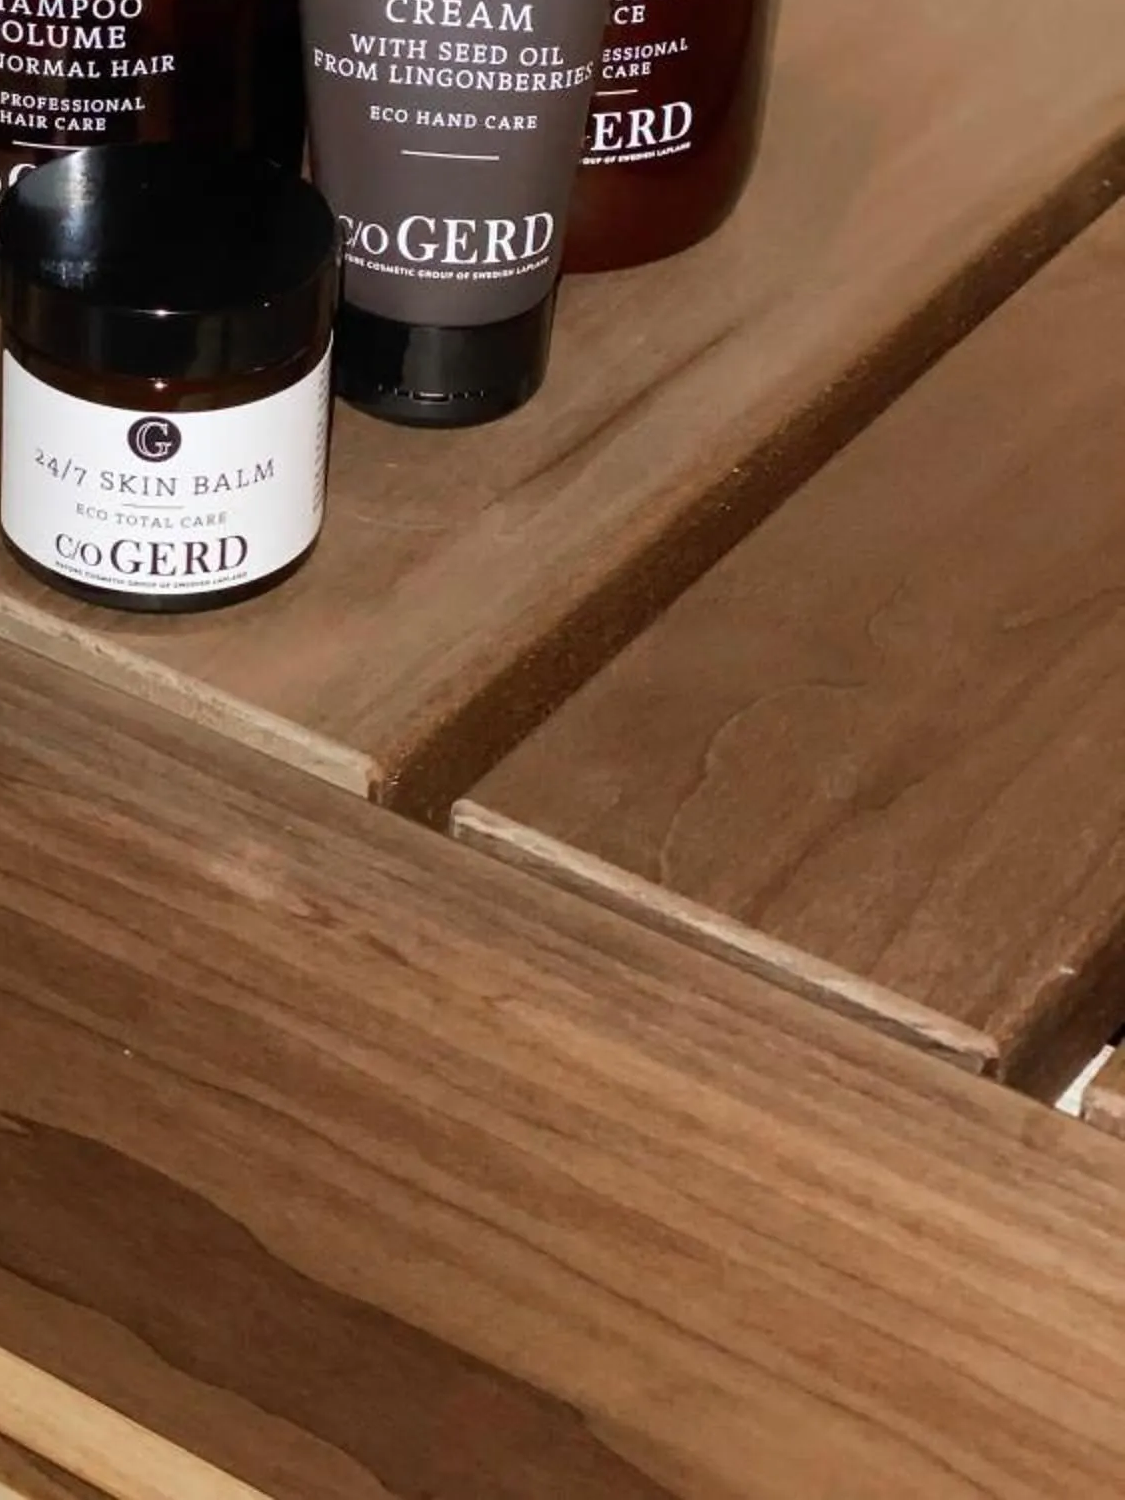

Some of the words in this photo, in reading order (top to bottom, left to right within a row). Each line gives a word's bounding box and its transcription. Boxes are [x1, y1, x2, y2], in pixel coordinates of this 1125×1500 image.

[349, 33, 428, 62] WITH
[438, 41, 508, 65] SEED
[519, 46, 564, 67] OIL
[110, 54, 175, 78] HAIR
[314, 48, 379, 82] FROM
[388, 60, 593, 92] LINGONBERRIES
[602, 59, 652, 79] CARE
[0, 91, 146, 114] PROFESSIONAL
[0, 109, 48, 129] HAIR
[54, 117, 106, 131] CARE
[370, 105, 409, 123] ECO
[416, 110, 478, 129] HAND
[484, 115, 538, 131] CARE
[587, 101, 693, 151] ERD
[396, 211, 554, 265] GERD
[34, 448, 87, 486] 24/7
[100, 470, 177, 497] SKIN
[193, 458, 274, 496] BALM
[75, 502, 108, 521] ECO
[114, 512, 173, 529] TOTAL
[179, 511, 227, 529] CARE
[109, 534, 249, 577] GERD
